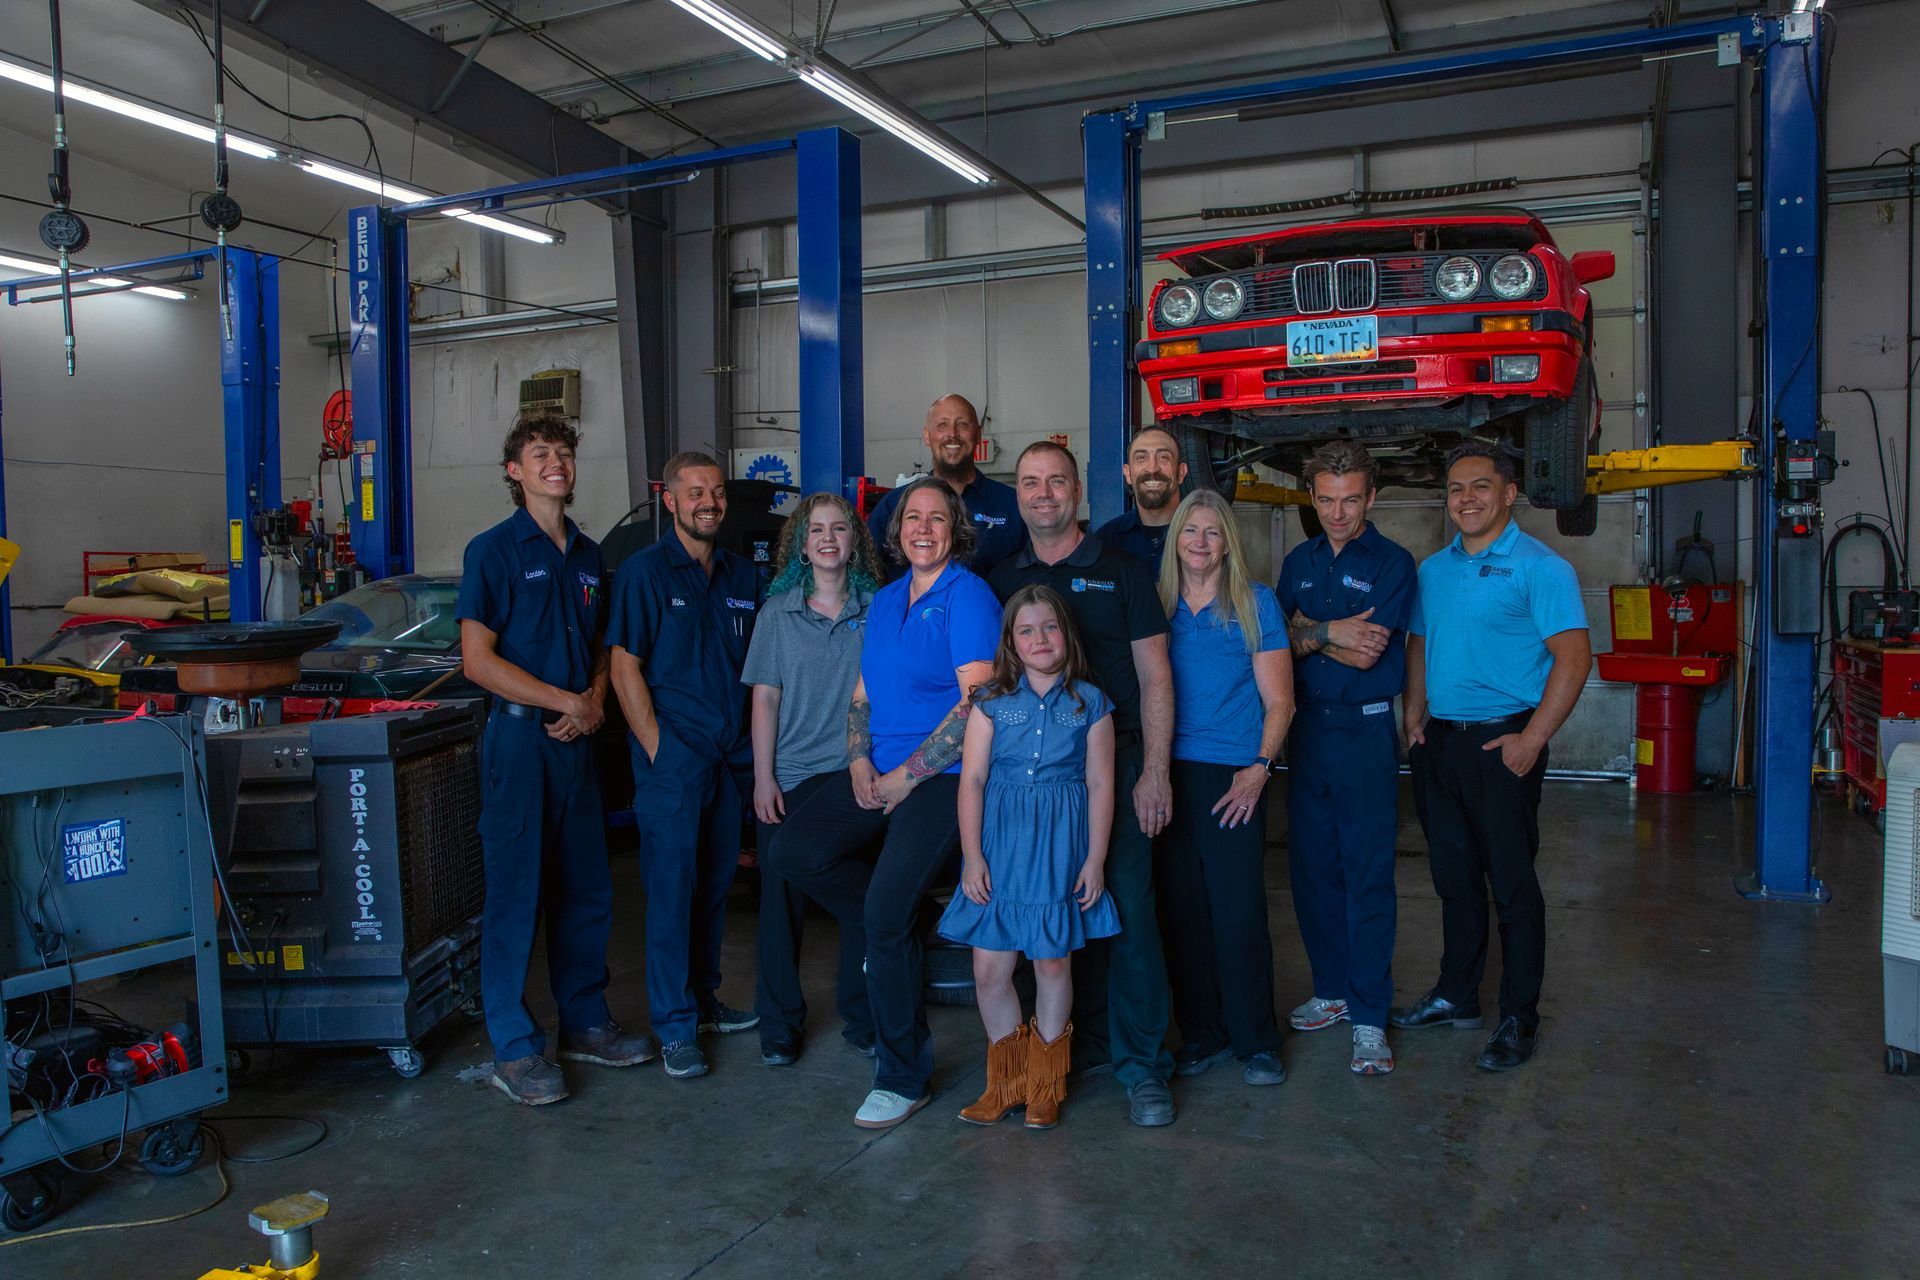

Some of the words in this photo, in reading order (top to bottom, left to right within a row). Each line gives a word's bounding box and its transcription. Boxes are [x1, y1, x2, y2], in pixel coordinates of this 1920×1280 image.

[356, 216, 369, 273] BEND
[358, 280, 369, 323] PAK
[1310, 319, 1353, 330] NEVADA
[1292, 334, 1324, 356] 610
[1339, 331, 1372, 353] TFJ
[71, 829, 98, 845] WORK
[99, 826, 120, 840] WITH
[79, 841, 105, 856] BUNCH
[106, 840, 118, 852] OF
[68, 849, 121, 881] TOOLS
